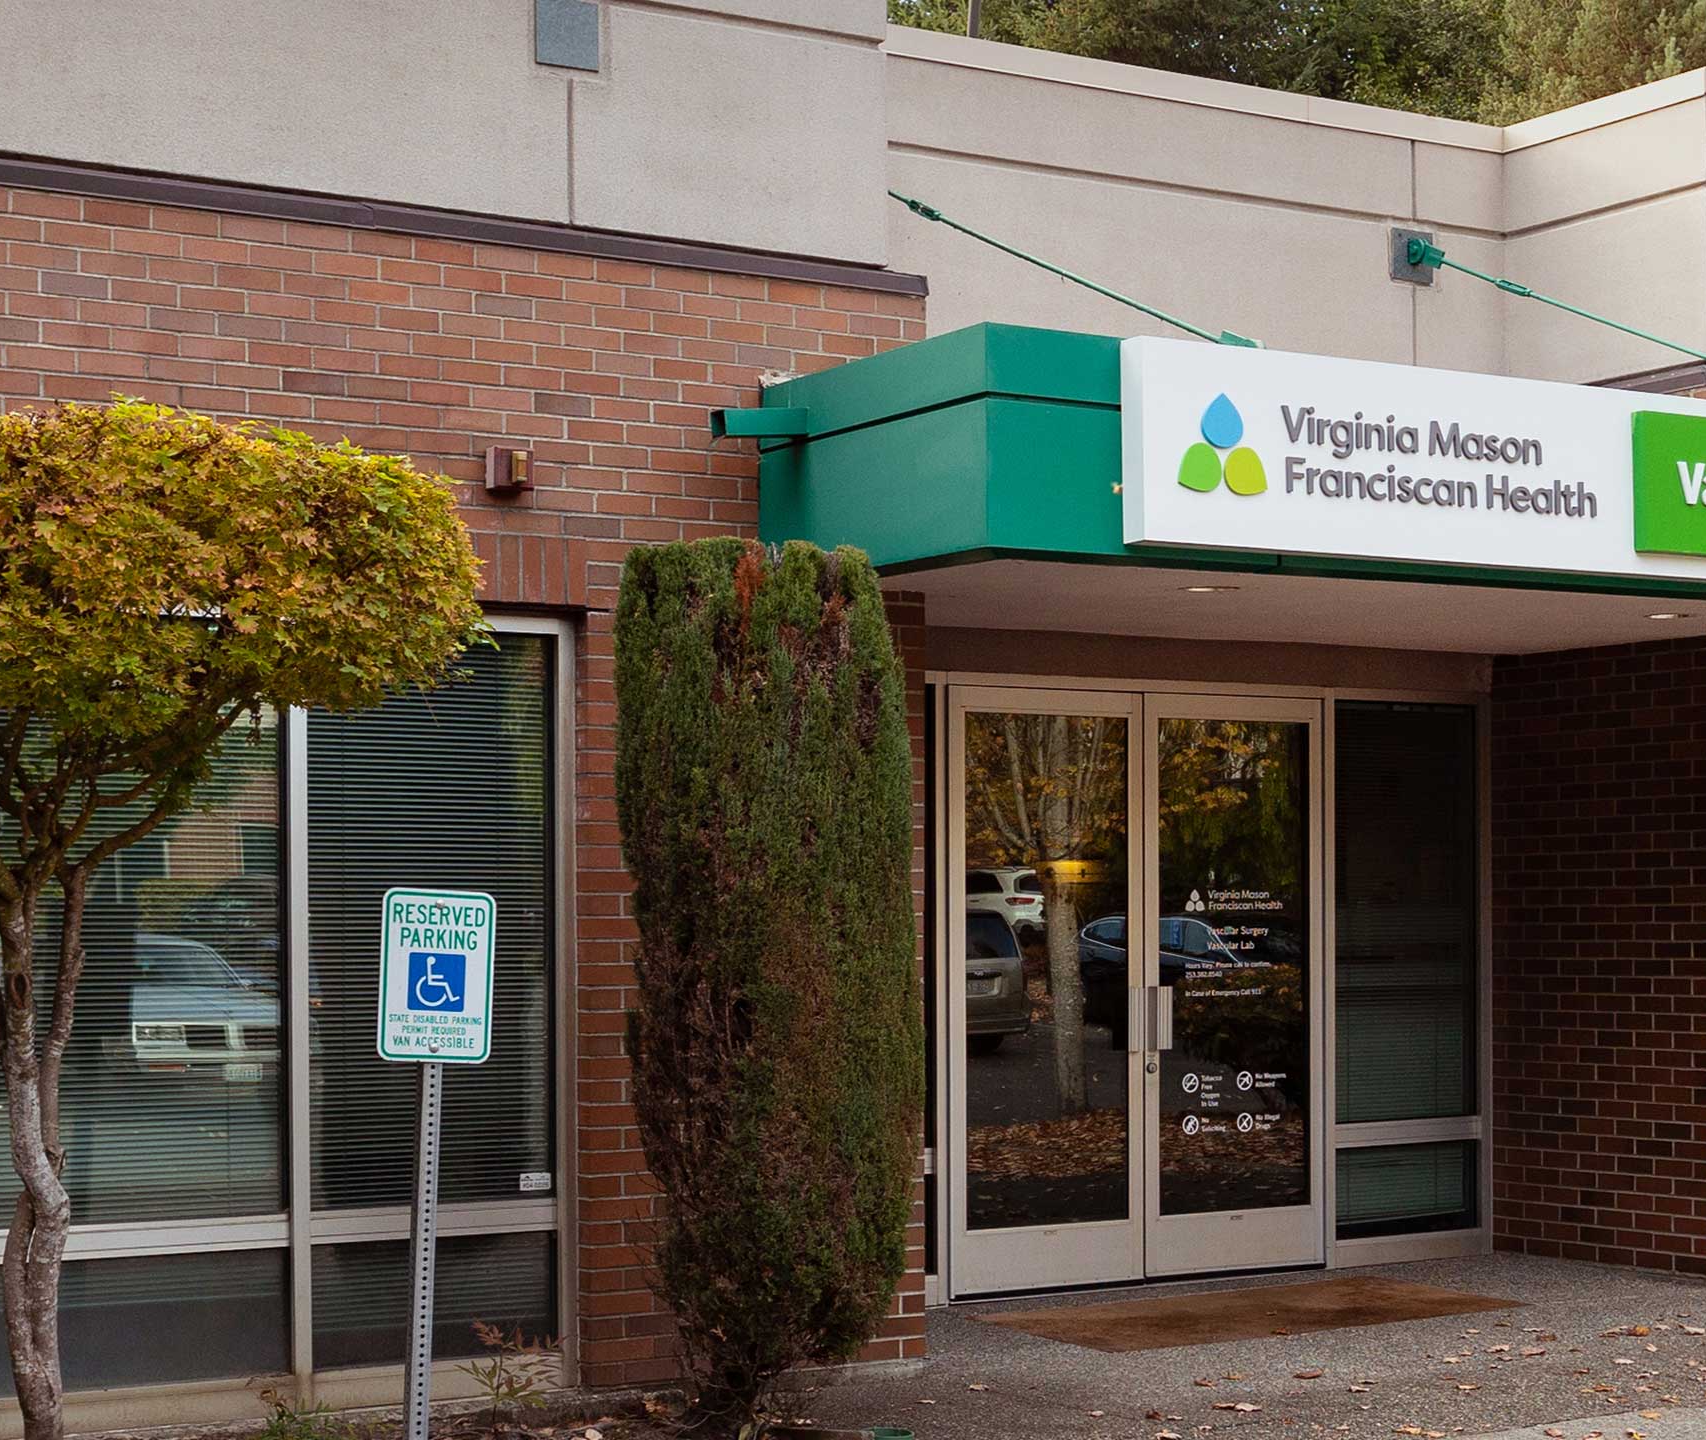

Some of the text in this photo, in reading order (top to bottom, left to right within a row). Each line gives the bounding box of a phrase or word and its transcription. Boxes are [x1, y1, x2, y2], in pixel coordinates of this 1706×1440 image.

[1281, 404, 1543, 466] Virginia Mason
[1285, 456, 1598, 518] Franciscan Health
[1207, 889, 1270, 901] Virginia Mason
[1208, 900, 1283, 911] Franciscan Health
[393, 903, 486, 928] RESERVED
[1240, 925, 1270, 936] Surgery
[400, 927, 478, 951] PARKING
[1240, 940, 1255, 950] Lab
[389, 1013, 482, 1026] STATE DISABLED PARKING
[401, 1025, 467, 1036] PERMIT REQUIRED
[392, 1035, 475, 1049] VAN ACCESSIBLE
